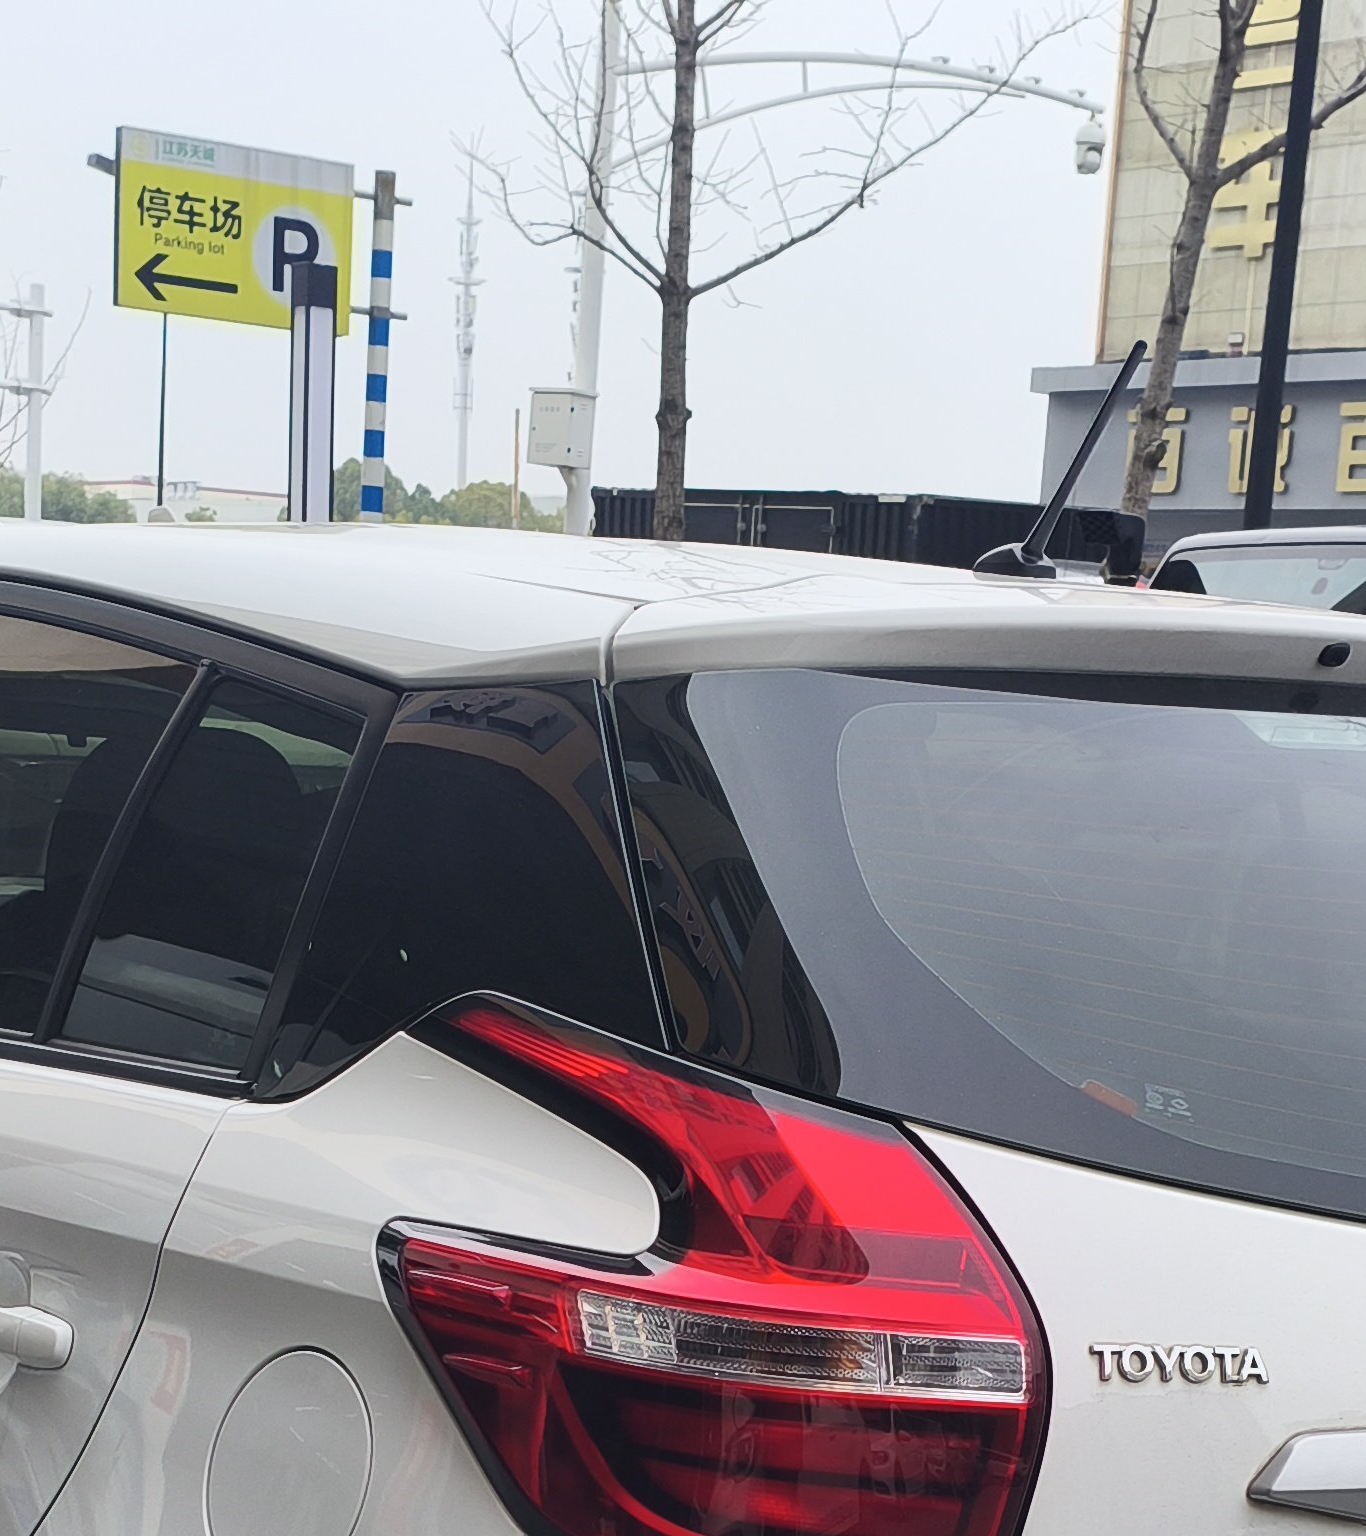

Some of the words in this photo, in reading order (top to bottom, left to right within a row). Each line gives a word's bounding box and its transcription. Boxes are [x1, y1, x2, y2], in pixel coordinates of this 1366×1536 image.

[137, 185, 242, 240] 停车场
[154, 232, 205, 255] Parking
[208, 240, 225, 255] lot
[272, 216, 319, 292] P
[1090, 1342, 1270, 1385] TOYOTA
